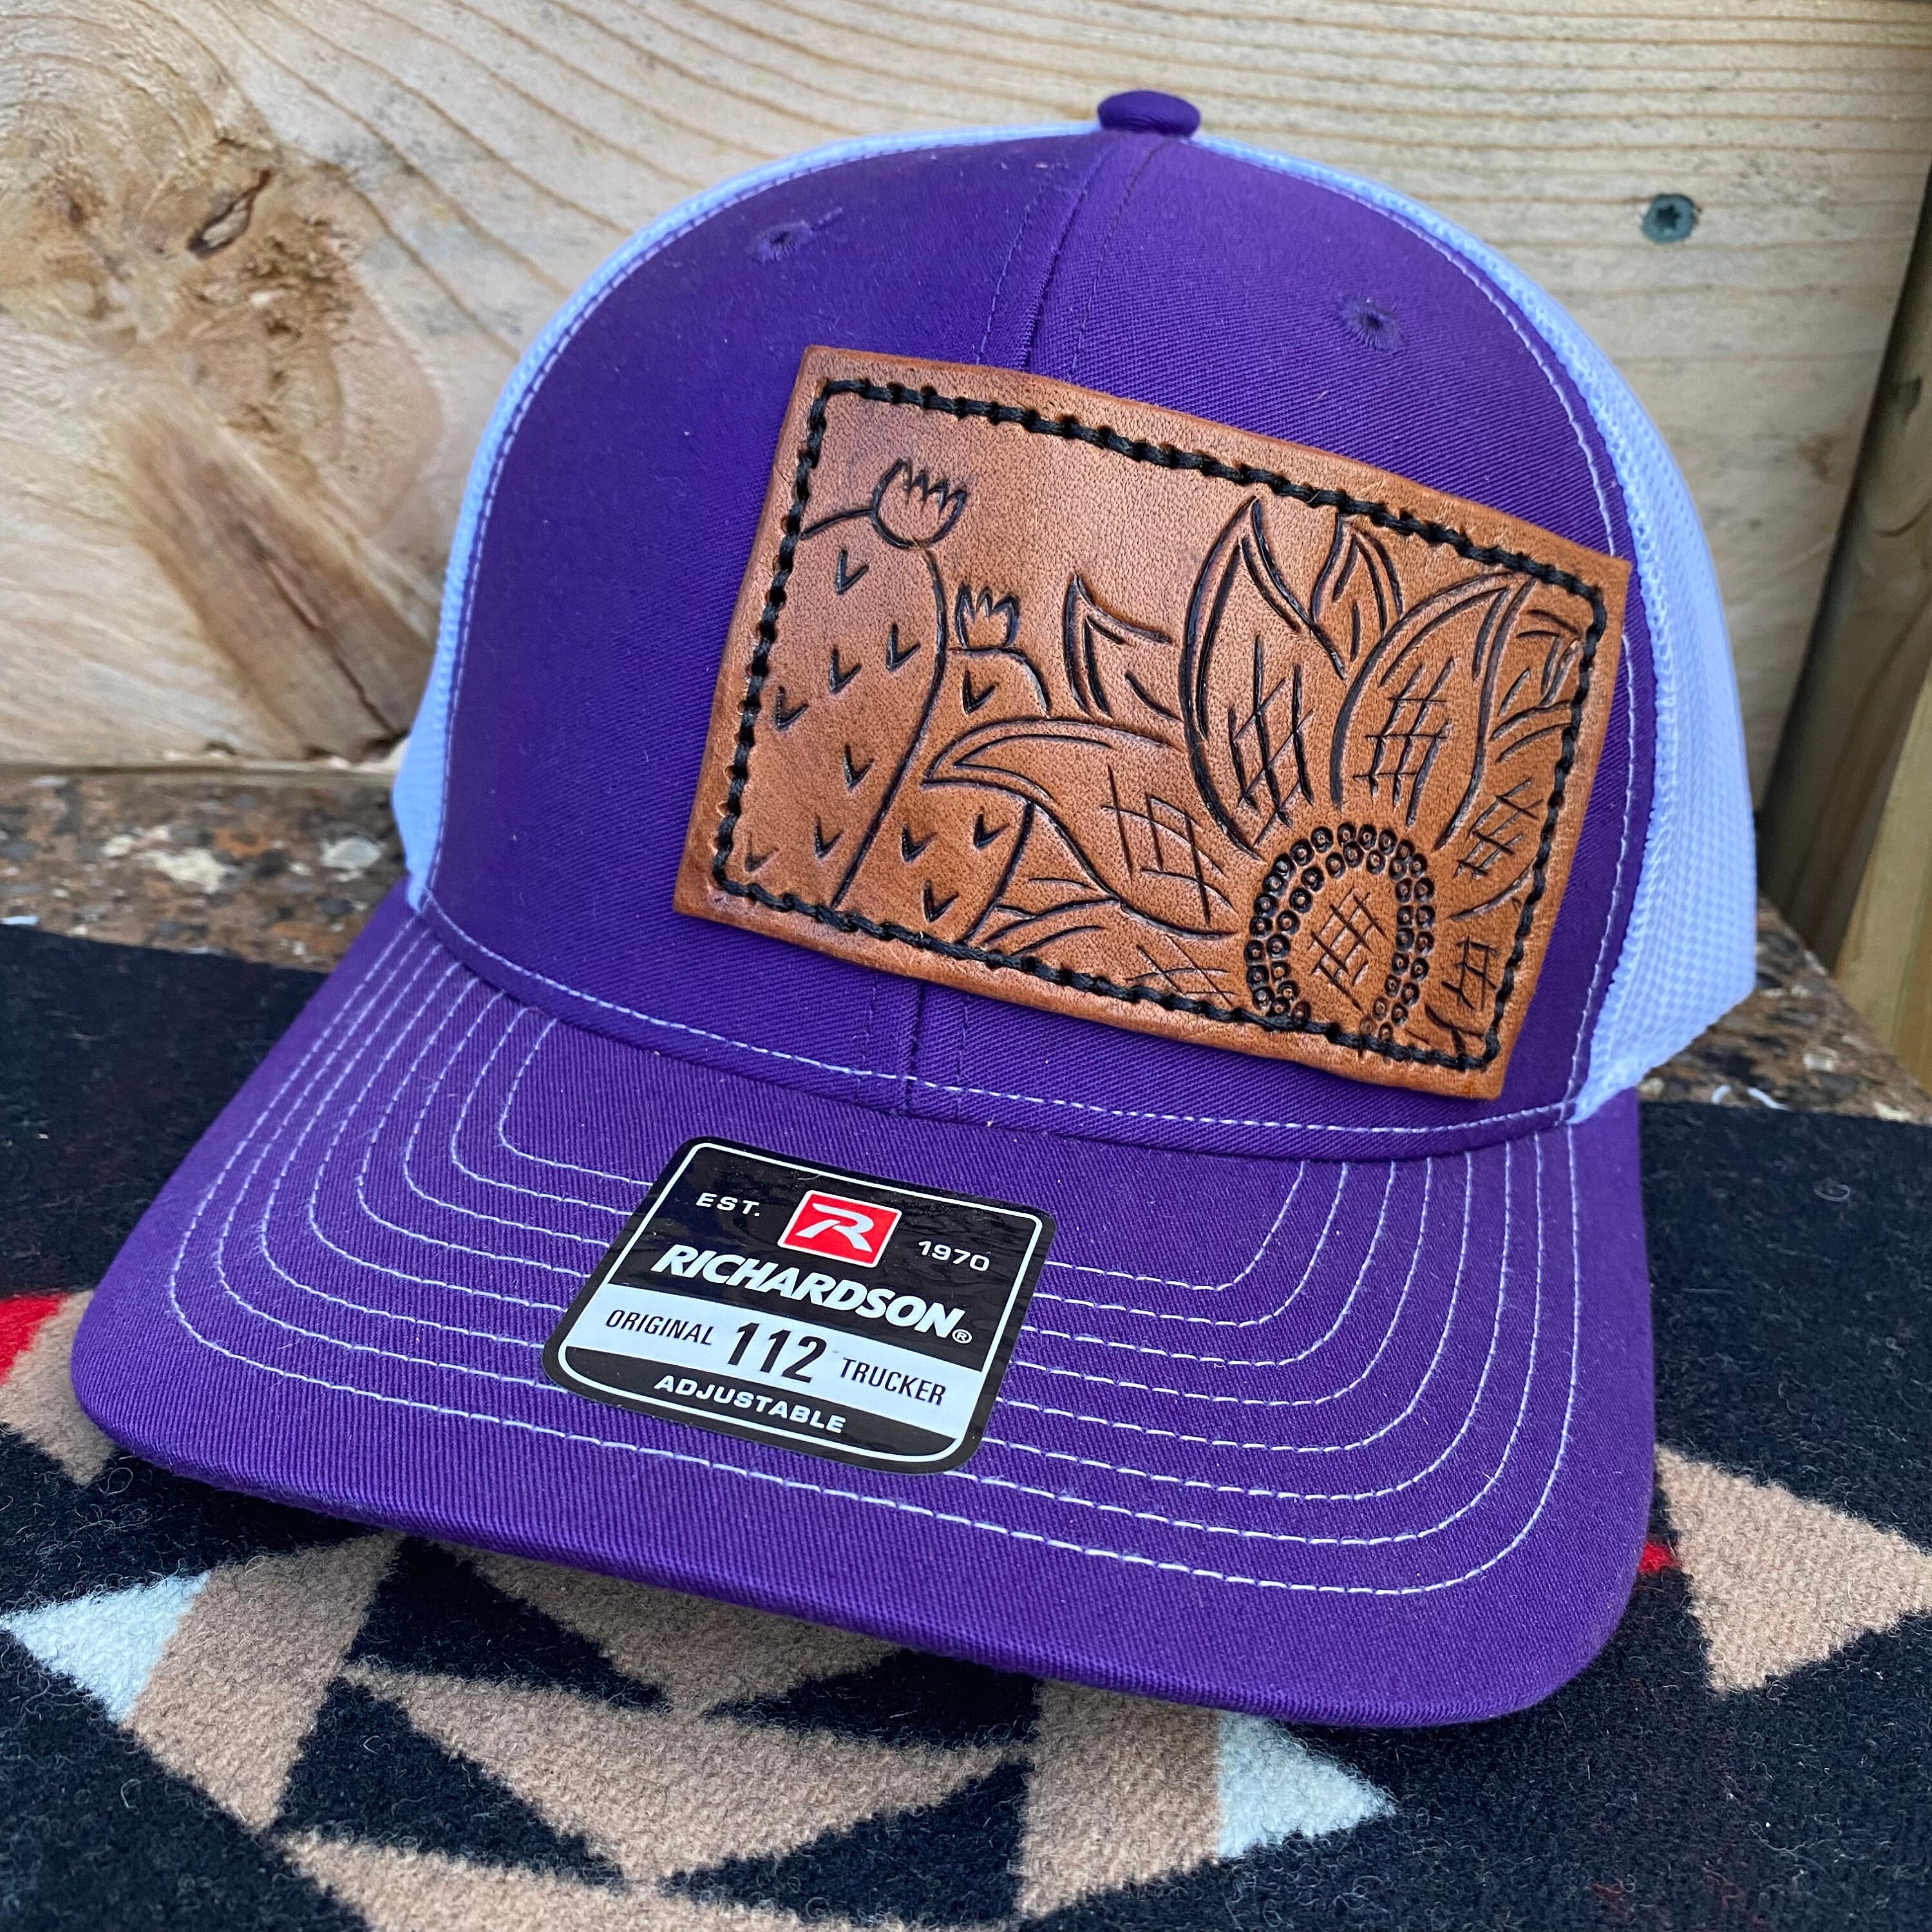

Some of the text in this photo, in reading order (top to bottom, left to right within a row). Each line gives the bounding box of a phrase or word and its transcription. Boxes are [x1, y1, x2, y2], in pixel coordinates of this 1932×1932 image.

[696, 1192, 761, 1216] EST.
[918, 1239, 990, 1272] 1970
[605, 1309, 947, 1406] ORIGINAL 112 TRUCKER
[654, 1375, 846, 1434] ADJUSTABLE
